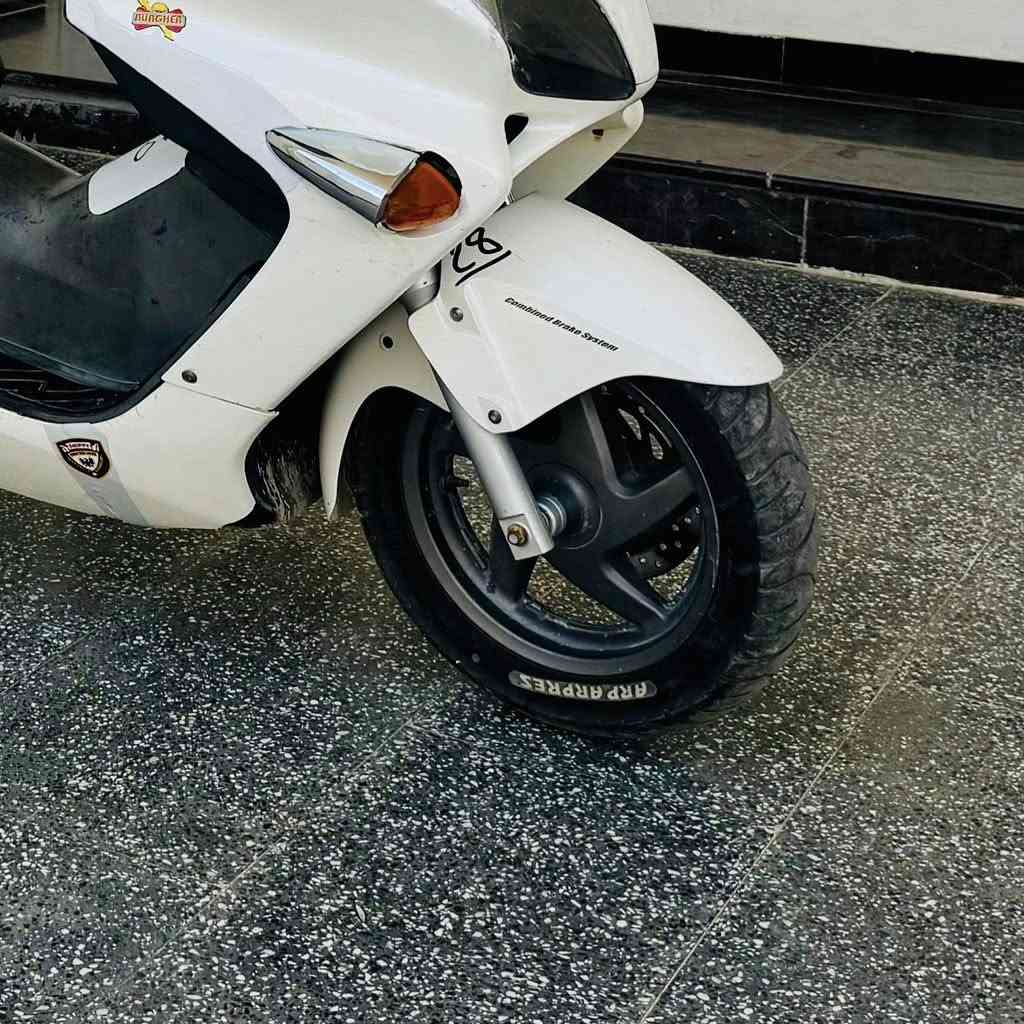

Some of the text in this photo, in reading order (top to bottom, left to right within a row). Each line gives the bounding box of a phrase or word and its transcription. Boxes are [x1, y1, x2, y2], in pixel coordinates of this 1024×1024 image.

[504, 296, 619, 352] Combined Brake System
